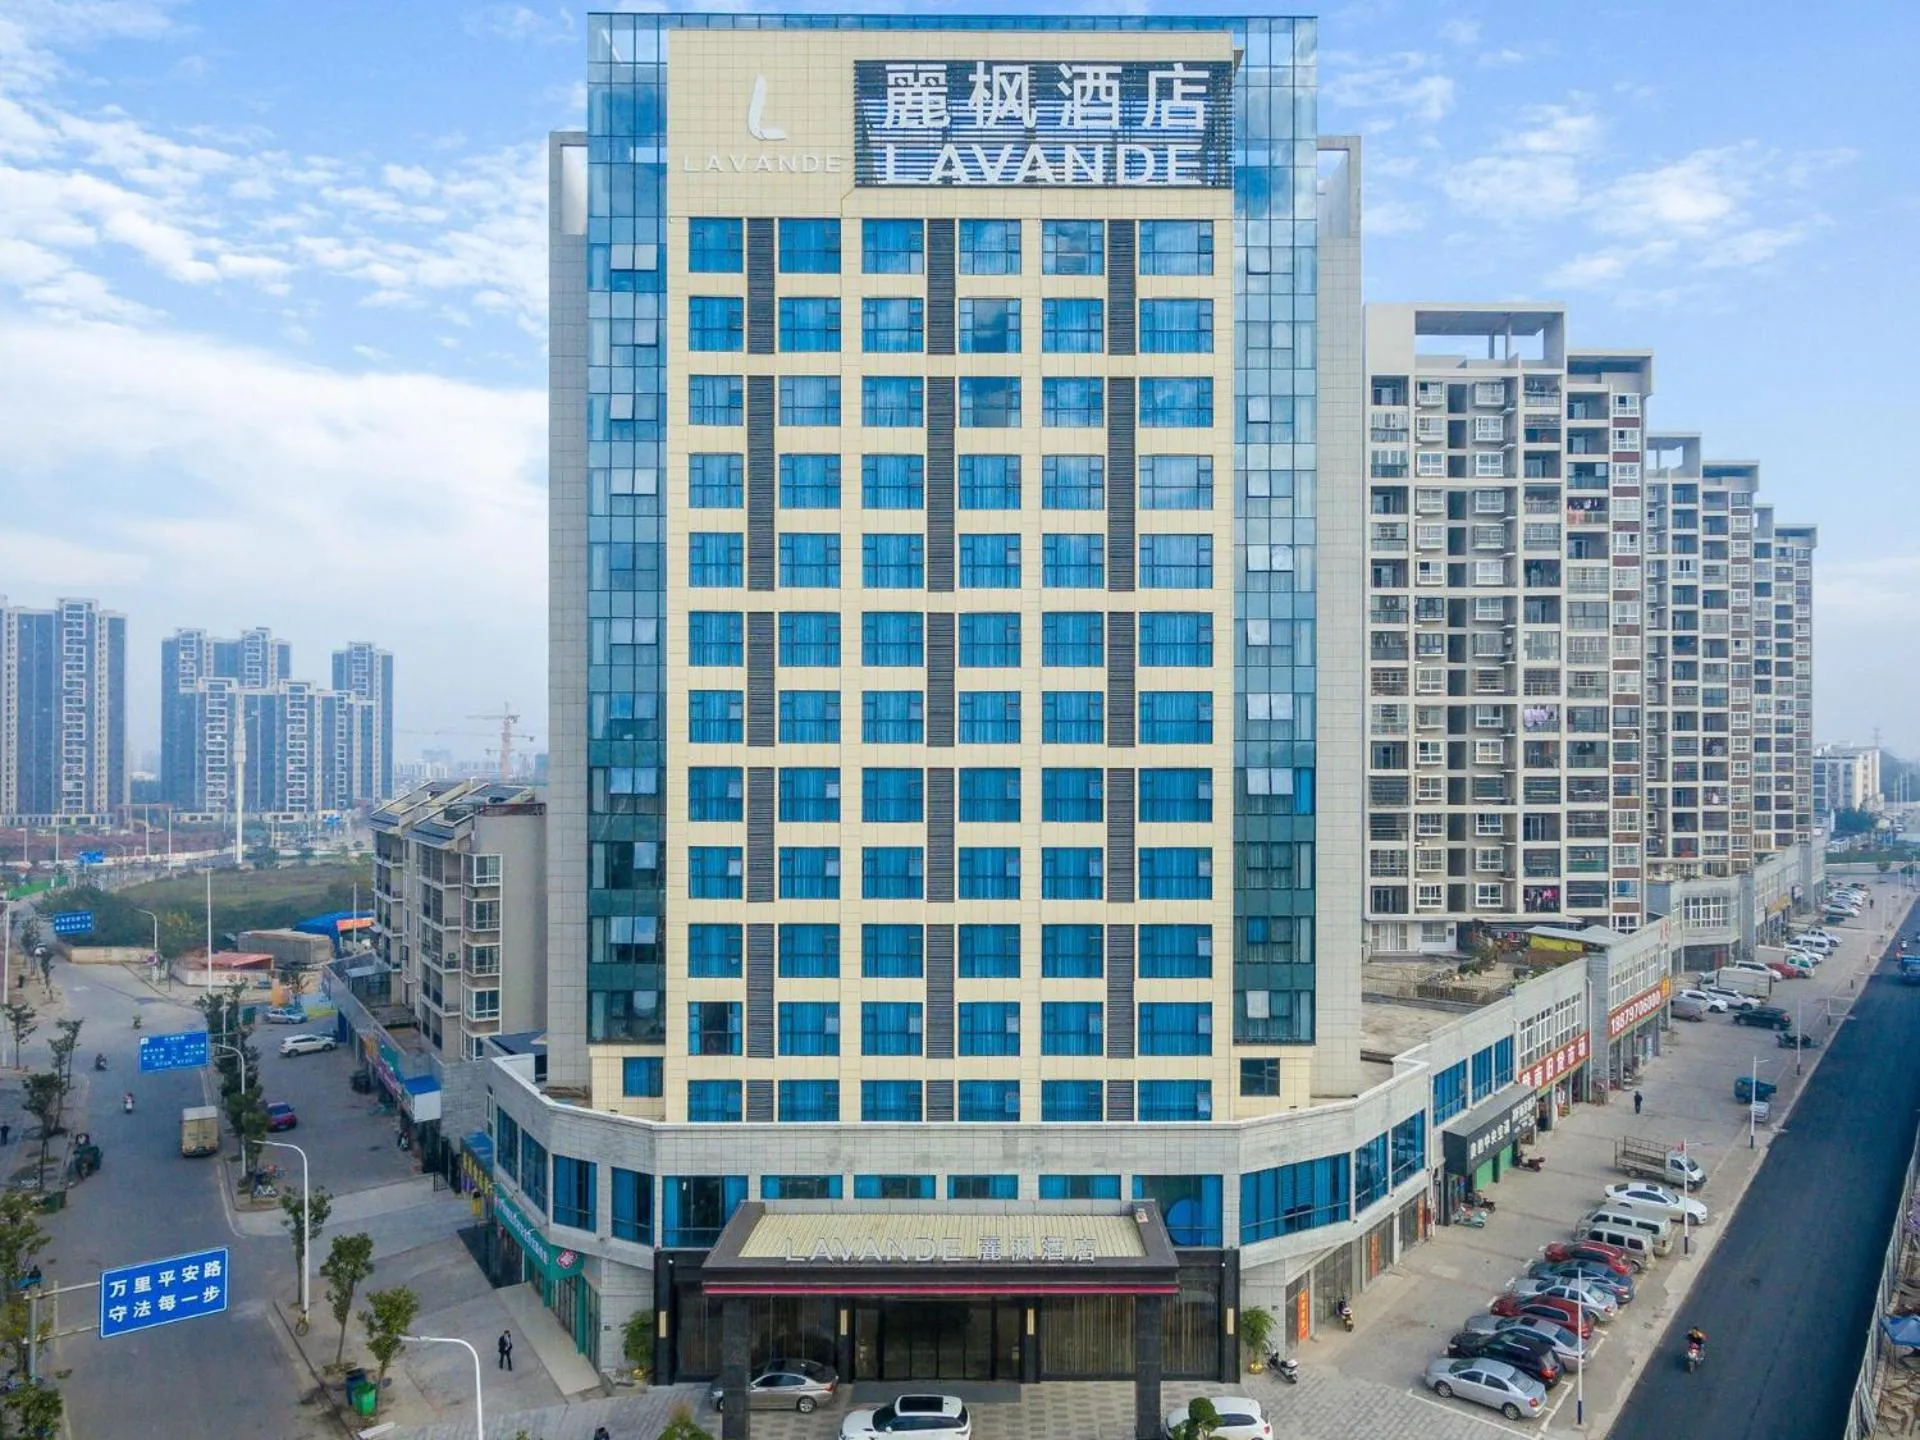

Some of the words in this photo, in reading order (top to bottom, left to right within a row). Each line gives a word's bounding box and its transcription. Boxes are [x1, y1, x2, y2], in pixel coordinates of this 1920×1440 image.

[885, 61, 1210, 129] 麗枫酒店
[683, 154, 841, 173] LAVANDE
[886, 144, 1204, 185] LAVANDE
[784, 1237, 962, 1264] LAVANDE
[977, 1236, 1097, 1263] 麗枫酒店
[108, 1260, 221, 1299] 万里平安路
[108, 1285, 221, 1323] 守法每一步
